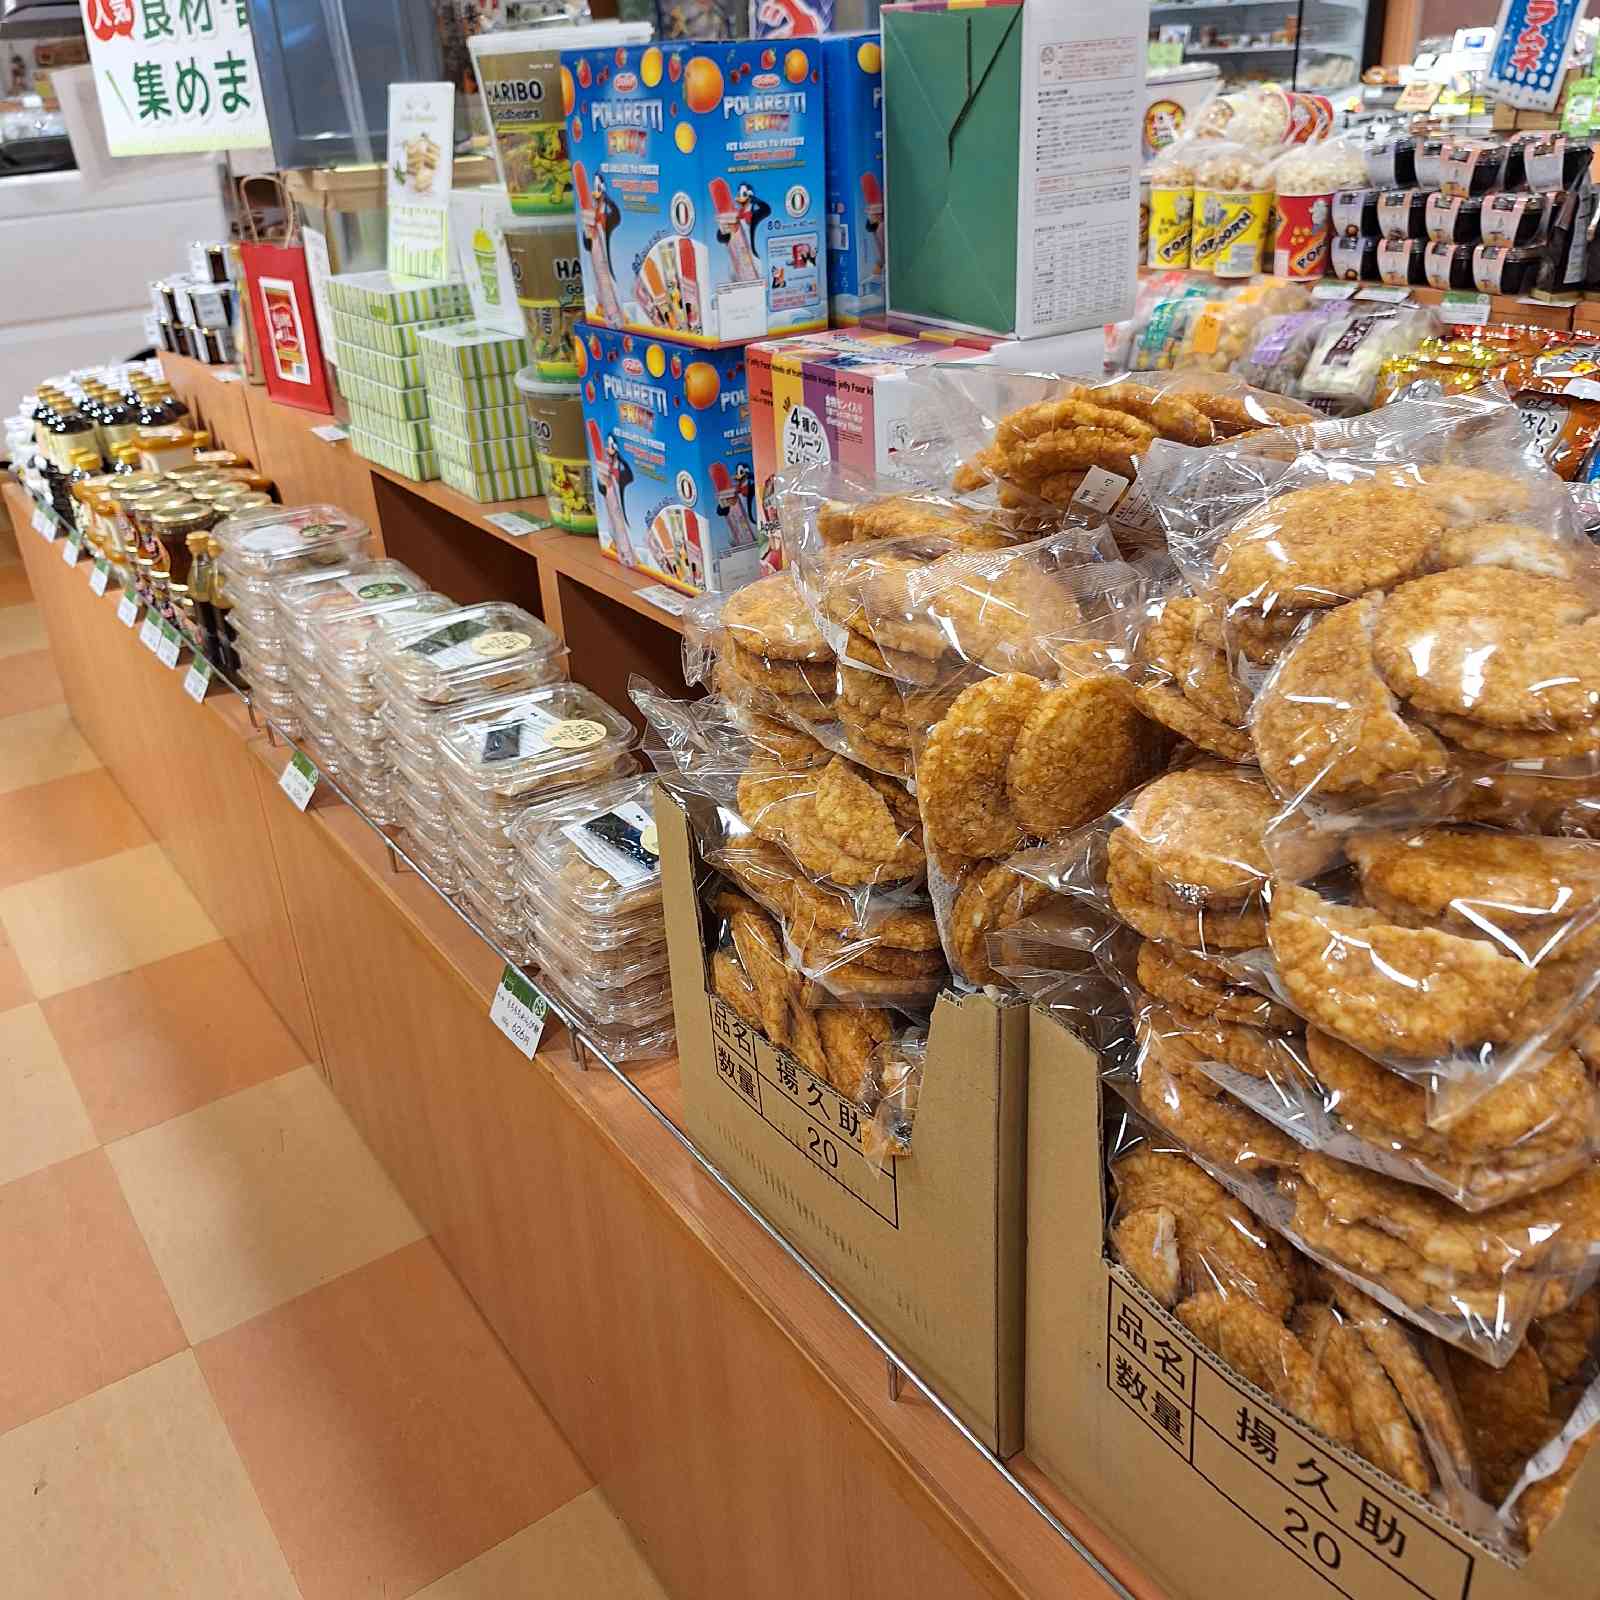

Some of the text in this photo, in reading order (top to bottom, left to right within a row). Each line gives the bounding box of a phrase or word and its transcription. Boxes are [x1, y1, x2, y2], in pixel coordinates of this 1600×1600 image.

[133, 51, 250, 120] 集めま
[485, 80, 543, 101] ARIBO
[723, 92, 806, 119] POLARETTI
[591, 99, 663, 132] POLARETTI
[720, 389, 747, 412] POL
[713, 1002, 751, 1055] 品名
[718, 1045, 757, 1103] 数量
[807, 1126, 838, 1168] 20
[1117, 1303, 1186, 1390] 品名
[1115, 1354, 1185, 1446] 数量
[1236, 1406, 1407, 1558] 揚久助
[1283, 1507, 1342, 1570] 20
